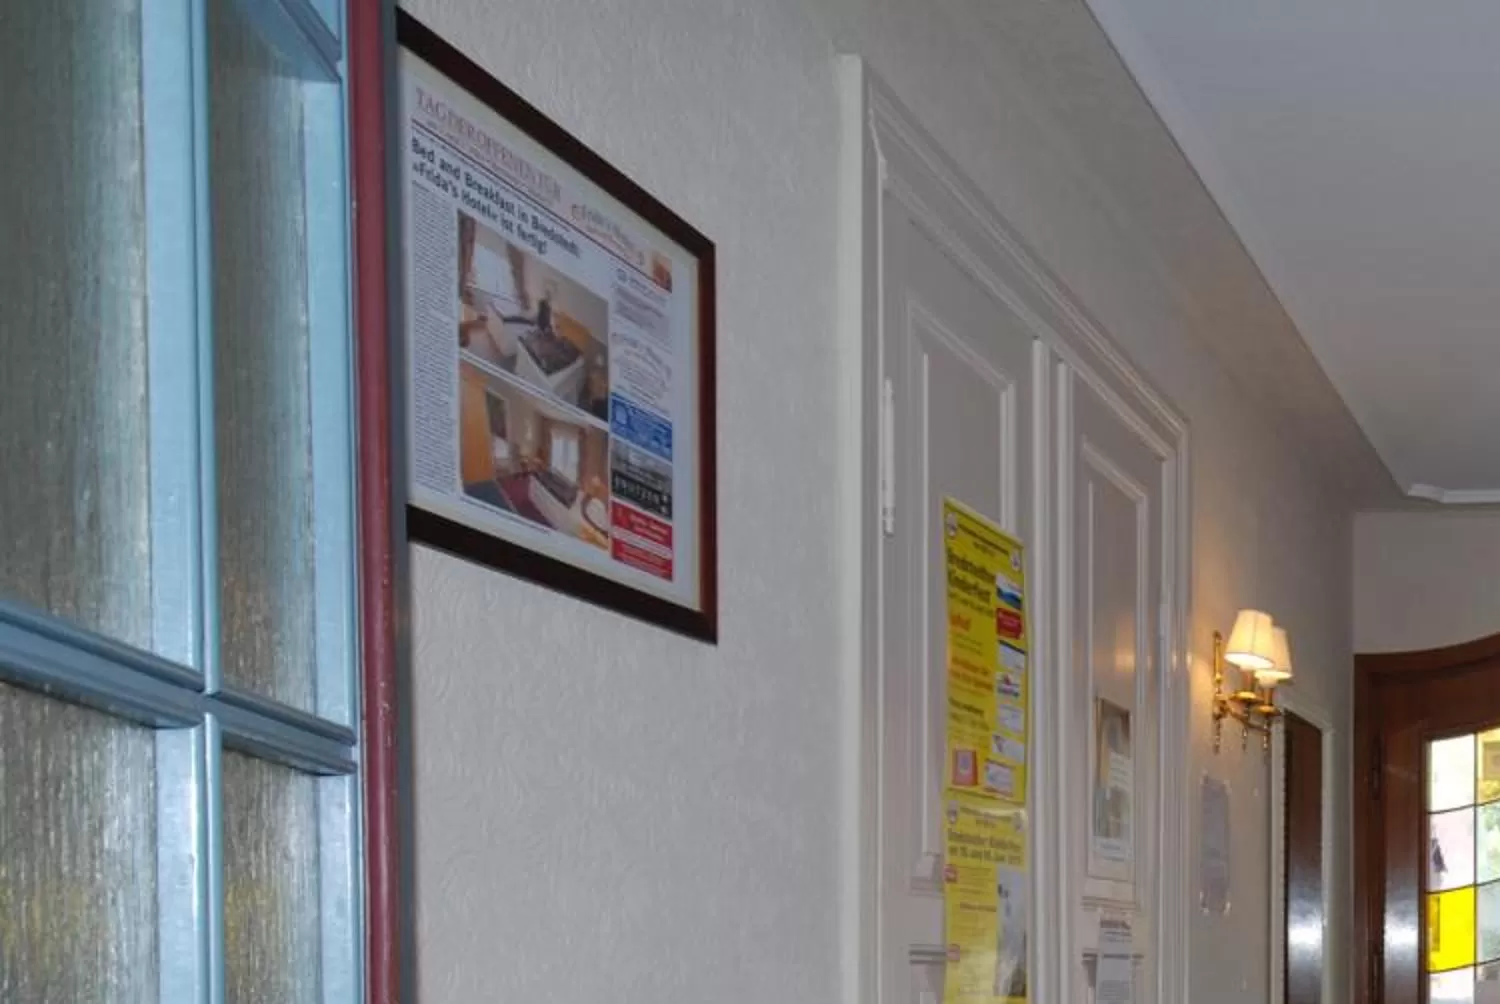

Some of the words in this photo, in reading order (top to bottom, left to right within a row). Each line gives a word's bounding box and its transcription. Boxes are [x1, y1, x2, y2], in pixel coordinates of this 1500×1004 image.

[412, 136, 435, 163] Bed
[438, 158, 460, 180] and
[464, 171, 515, 215] Breakfast
